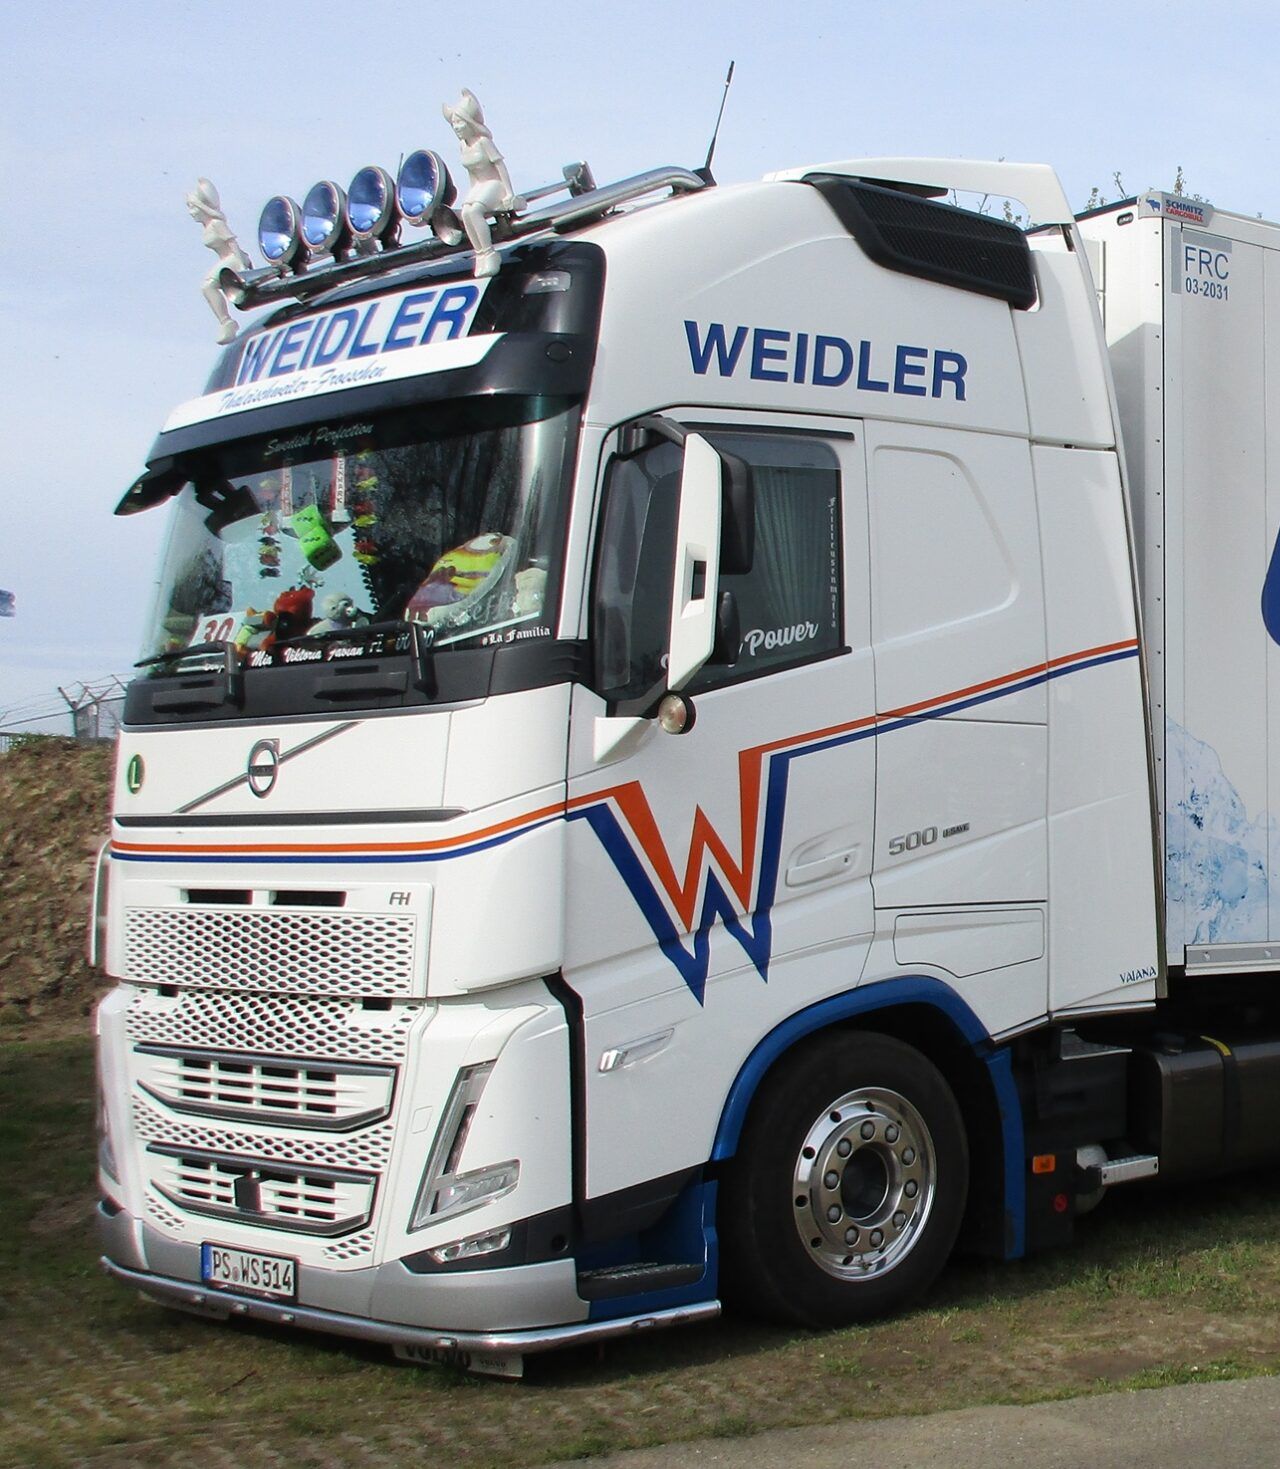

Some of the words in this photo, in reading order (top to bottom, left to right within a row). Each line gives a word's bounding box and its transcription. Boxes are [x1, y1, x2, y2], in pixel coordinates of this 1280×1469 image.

[1165, 200, 1204, 217] SCHMITZ
[1165, 207, 1204, 222] CARGOBULL
[1184, 245, 1229, 280] FRC
[1185, 277, 1229, 301] 03-2031
[236, 284, 480, 386] WEIDLER
[683, 320, 969, 402] WEIDLER
[506, 626, 550, 643] Familia
[744, 621, 820, 657] Power
[130, 761, 141, 788] L
[888, 826, 939, 856] 500
[389, 891, 412, 906] FH
[212, 1250, 231, 1279] PS
